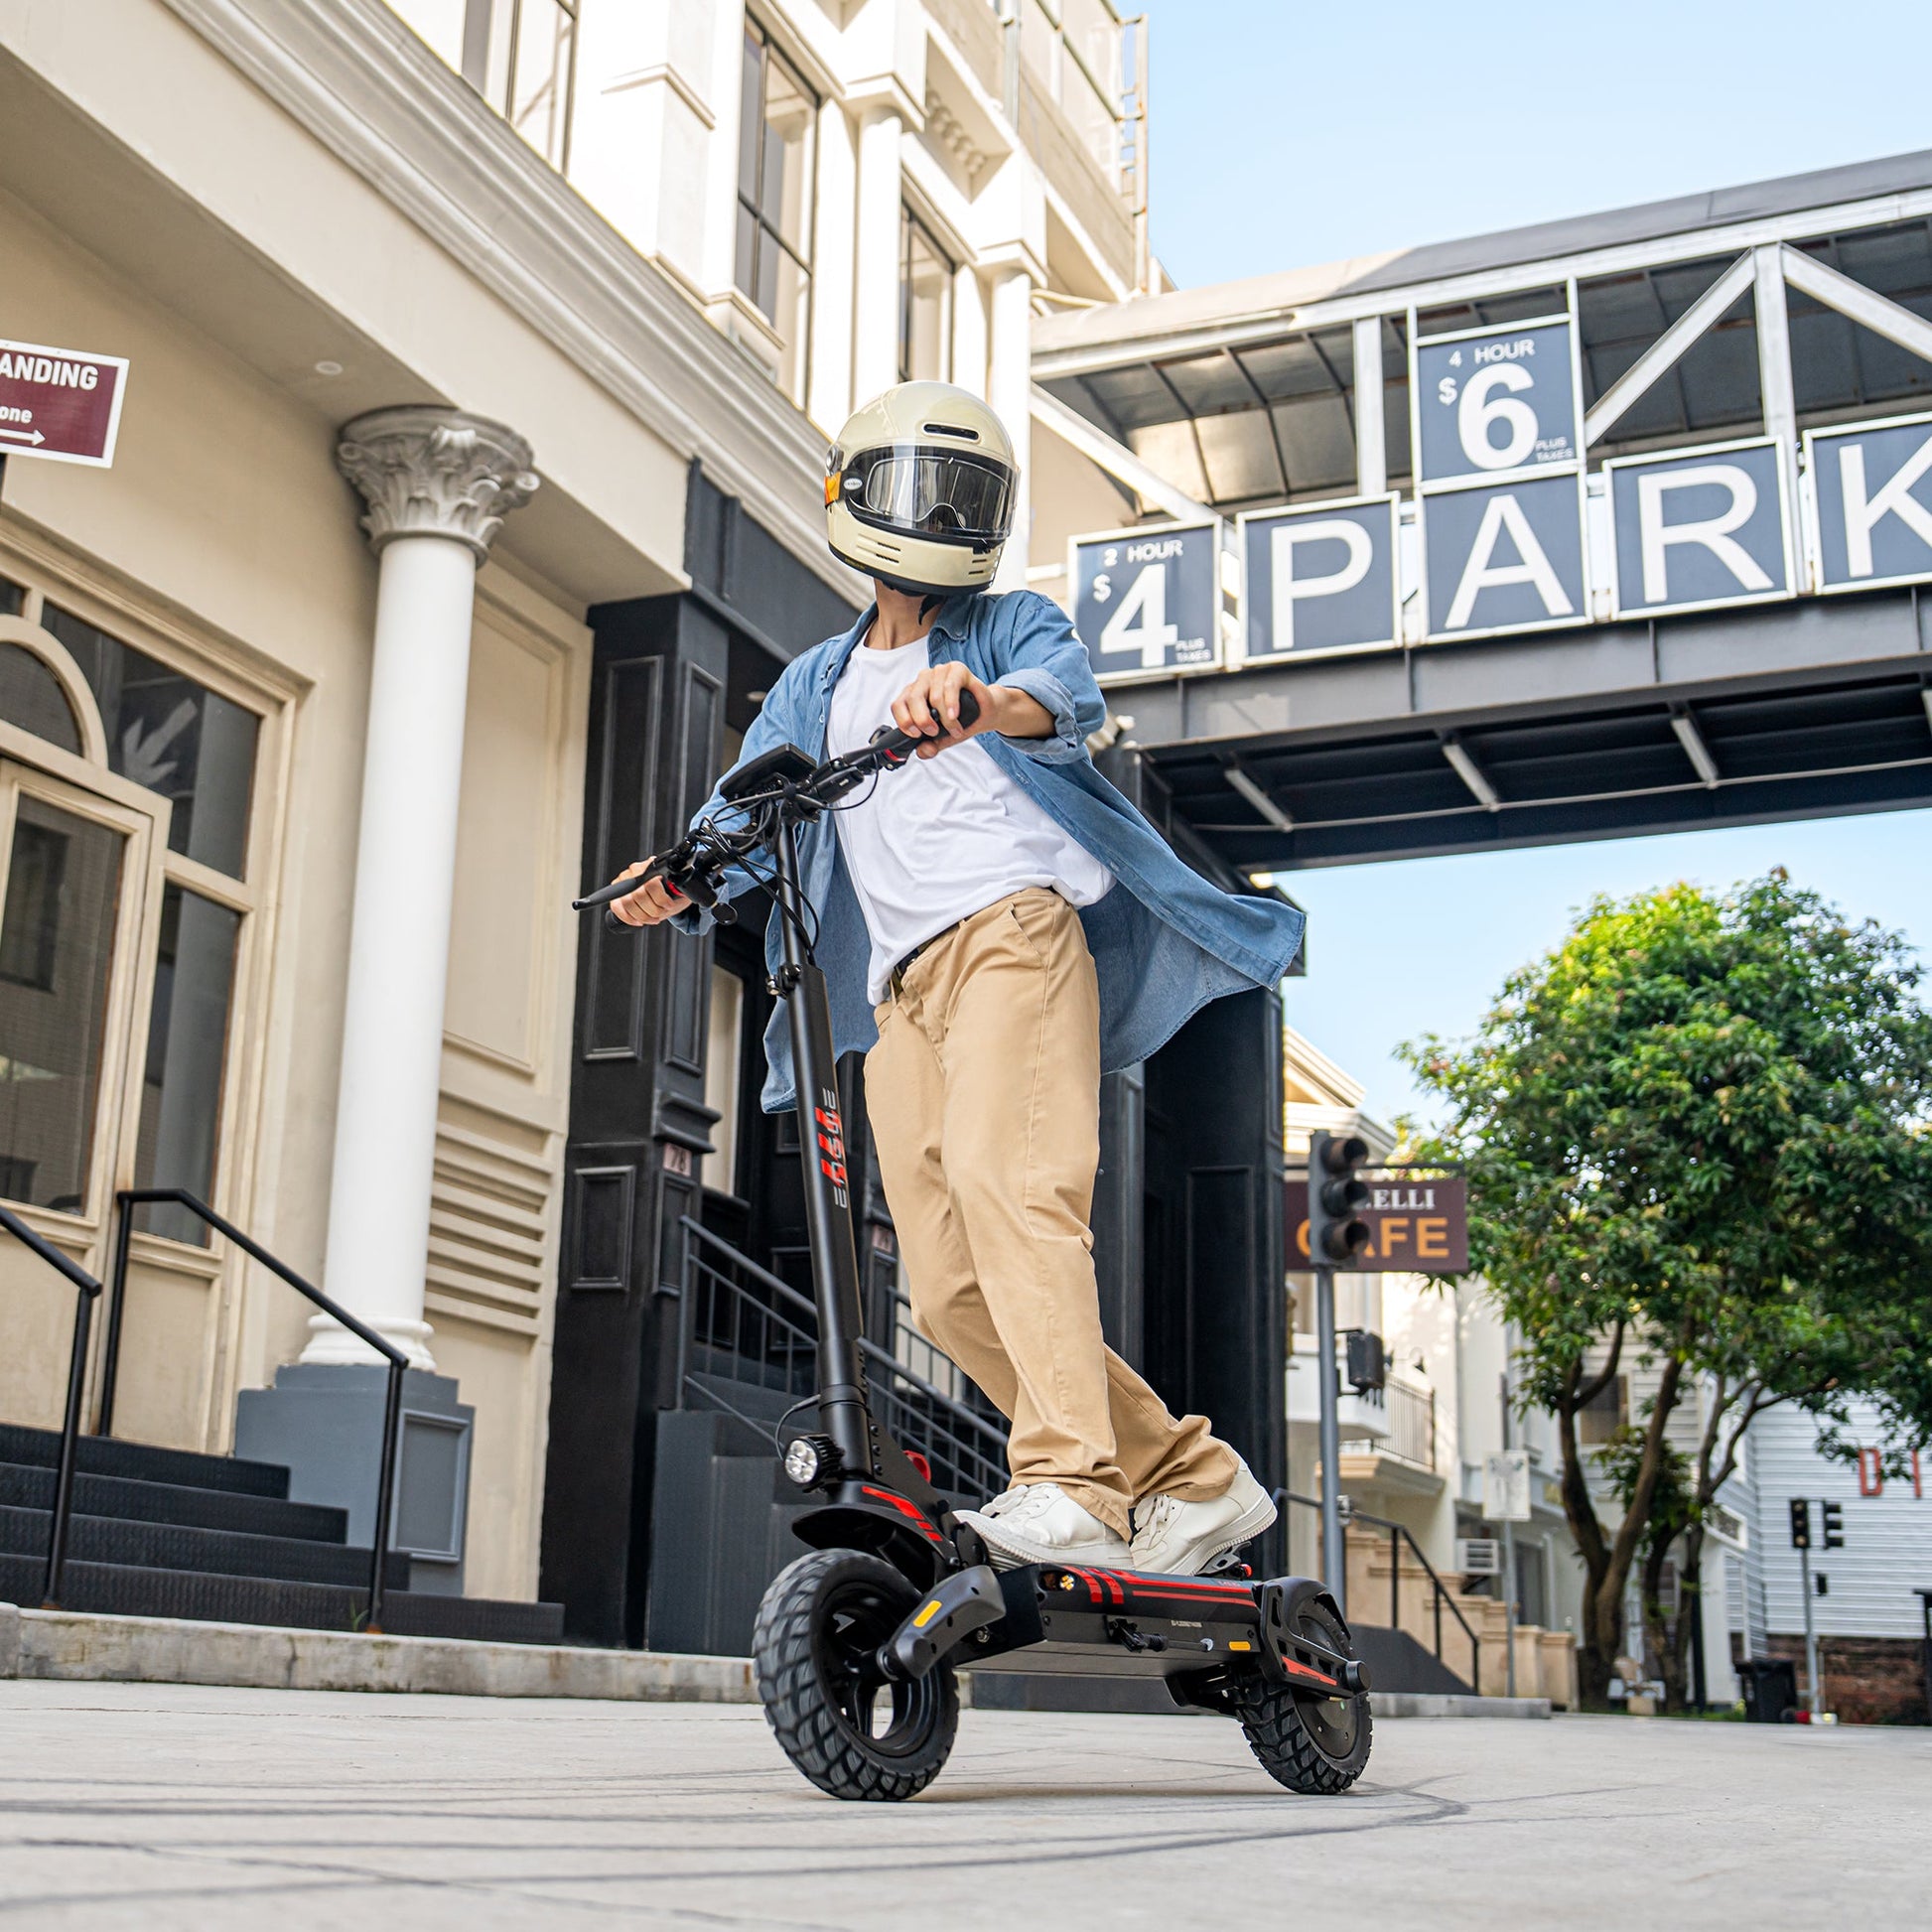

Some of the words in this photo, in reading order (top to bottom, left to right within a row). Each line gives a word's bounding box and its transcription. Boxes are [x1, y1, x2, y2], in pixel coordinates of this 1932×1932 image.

[1449, 350, 1462, 367] 4
[1473, 339, 1535, 364] HOUR
[1127, 540, 1183, 563] HOUR
[1365, 1188, 1436, 1210] ELLI
[1296, 1217, 1450, 1259] FE
